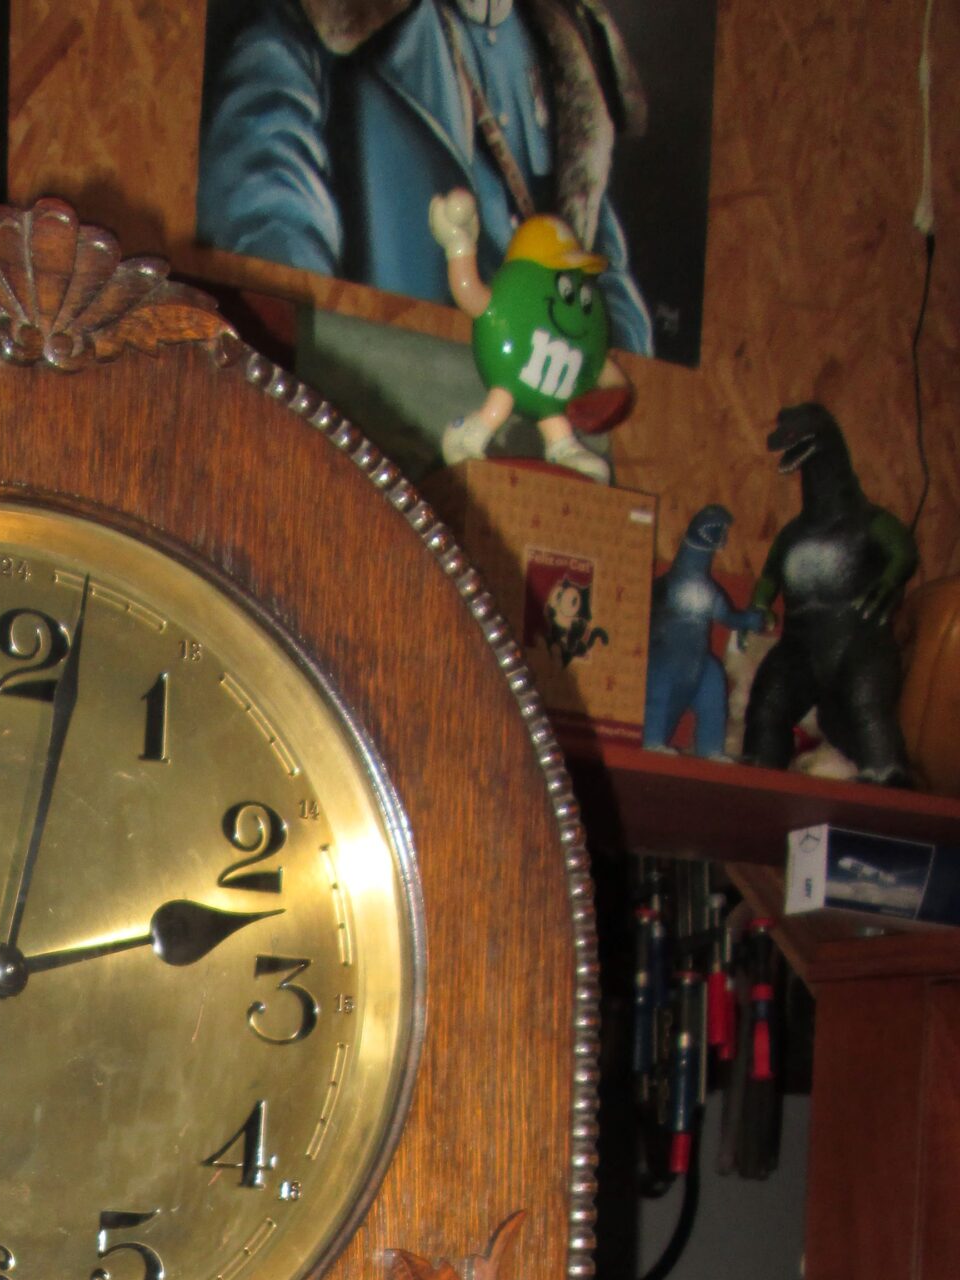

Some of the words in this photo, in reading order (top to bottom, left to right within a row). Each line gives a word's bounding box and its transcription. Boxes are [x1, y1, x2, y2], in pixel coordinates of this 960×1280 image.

[1, 557, 32, 582] 24
[138, 671, 170, 764] 1
[217, 800, 288, 893] 2
[299, 799, 320, 820] 14
[248, 954, 319, 1045] 3
[202, 1100, 276, 1190] 4
